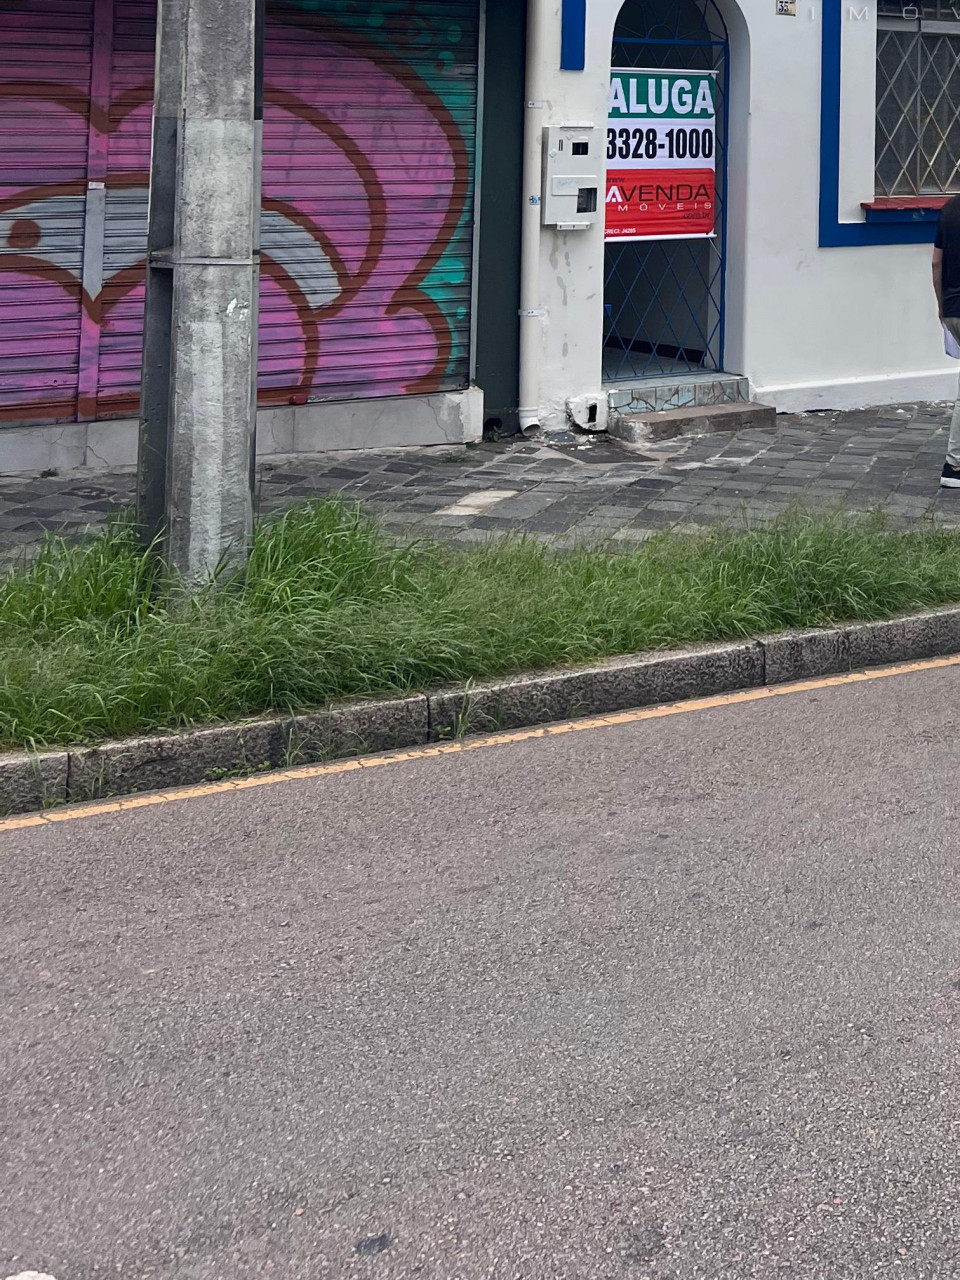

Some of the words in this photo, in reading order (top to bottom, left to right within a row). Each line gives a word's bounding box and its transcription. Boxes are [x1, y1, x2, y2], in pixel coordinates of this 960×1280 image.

[608, 77, 715, 115] ALUGA
[606, 127, 713, 160] 3328-1000
[605, 183, 711, 203] AVENDA
